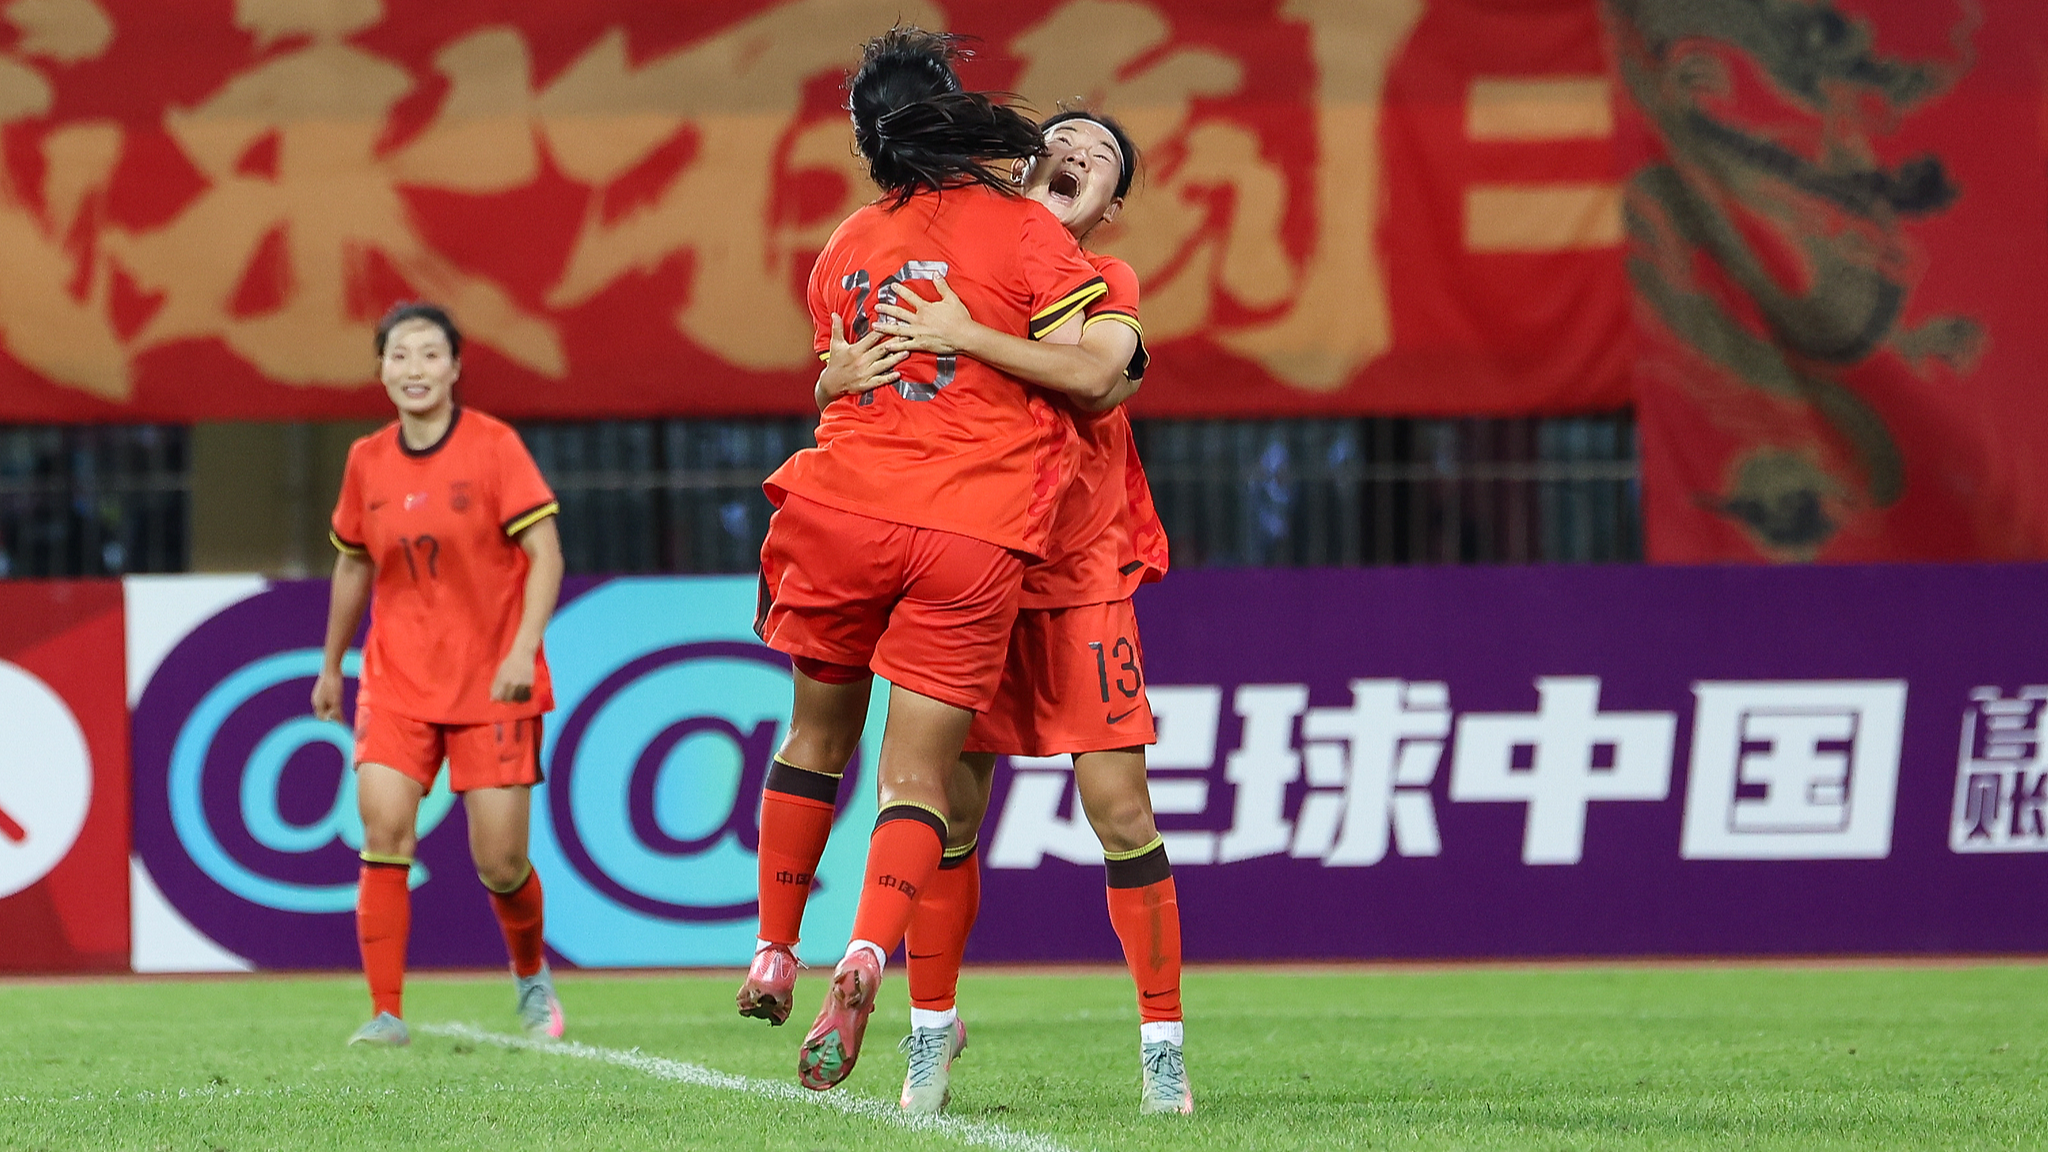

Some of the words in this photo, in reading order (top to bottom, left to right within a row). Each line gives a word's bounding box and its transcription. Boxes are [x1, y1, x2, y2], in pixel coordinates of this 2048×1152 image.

[400, 534, 440, 583] 17
[1088, 636, 1141, 703] 13
[986, 676, 1909, 866] 足球中国
[776, 870, 813, 886] 中国
[878, 874, 917, 900] 中国
